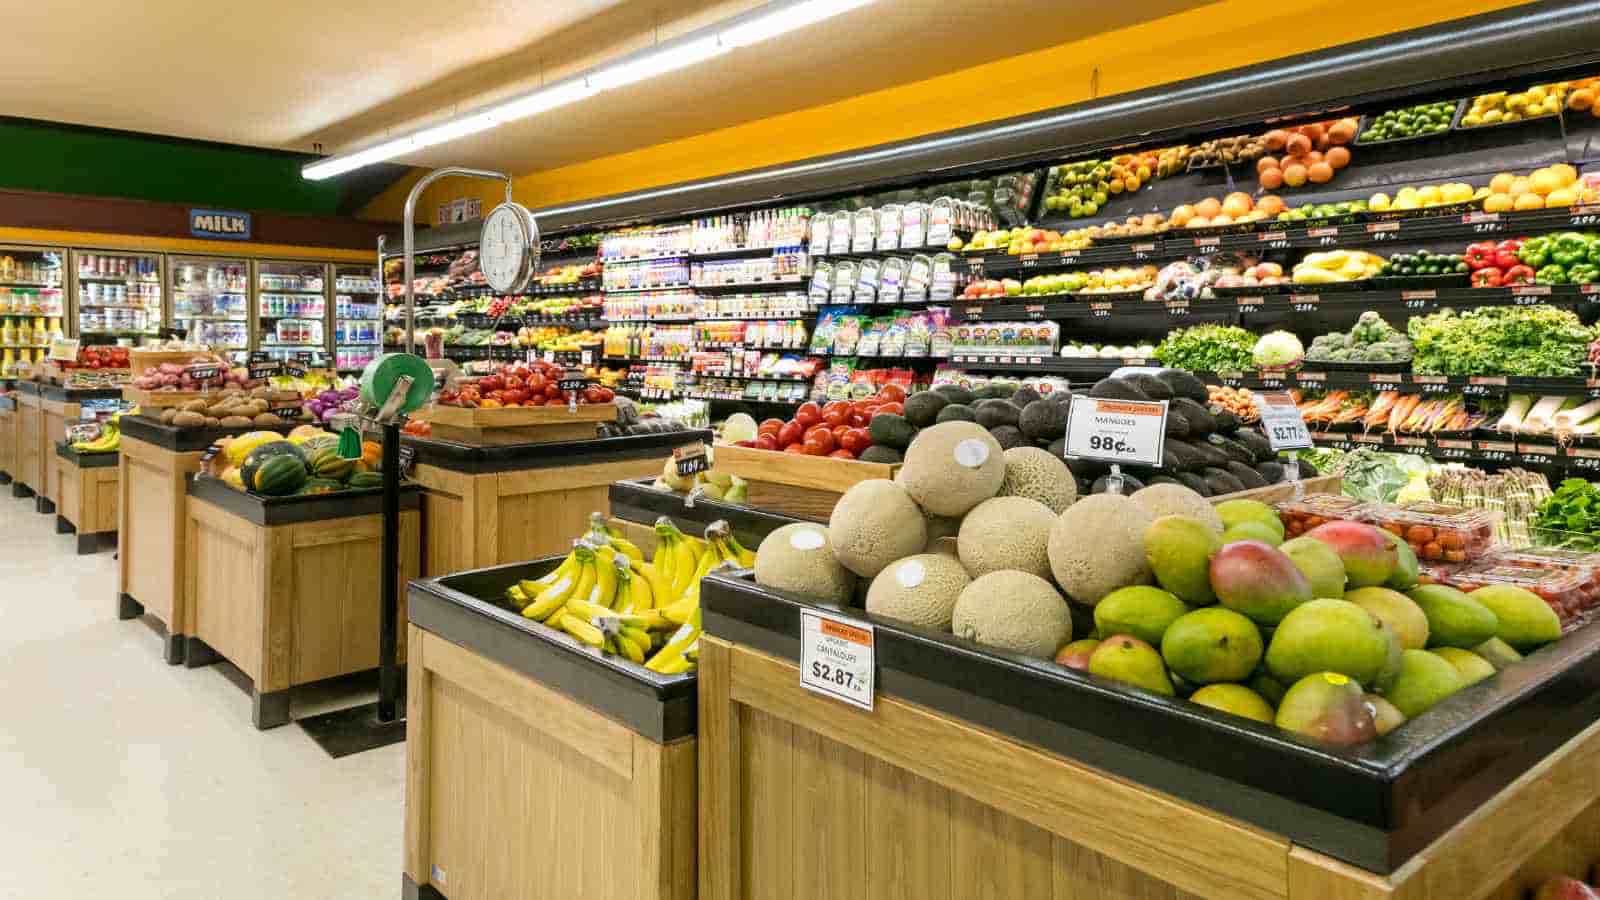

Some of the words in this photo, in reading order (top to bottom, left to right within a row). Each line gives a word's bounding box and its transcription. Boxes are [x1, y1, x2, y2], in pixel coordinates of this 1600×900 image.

[194, 215, 245, 232] MILK
[1095, 416, 1136, 426] MANGOES
[1273, 426, 1297, 440] $2.77
[1090, 435, 1126, 455] 98¢
[812, 661, 854, 688] $2.87
